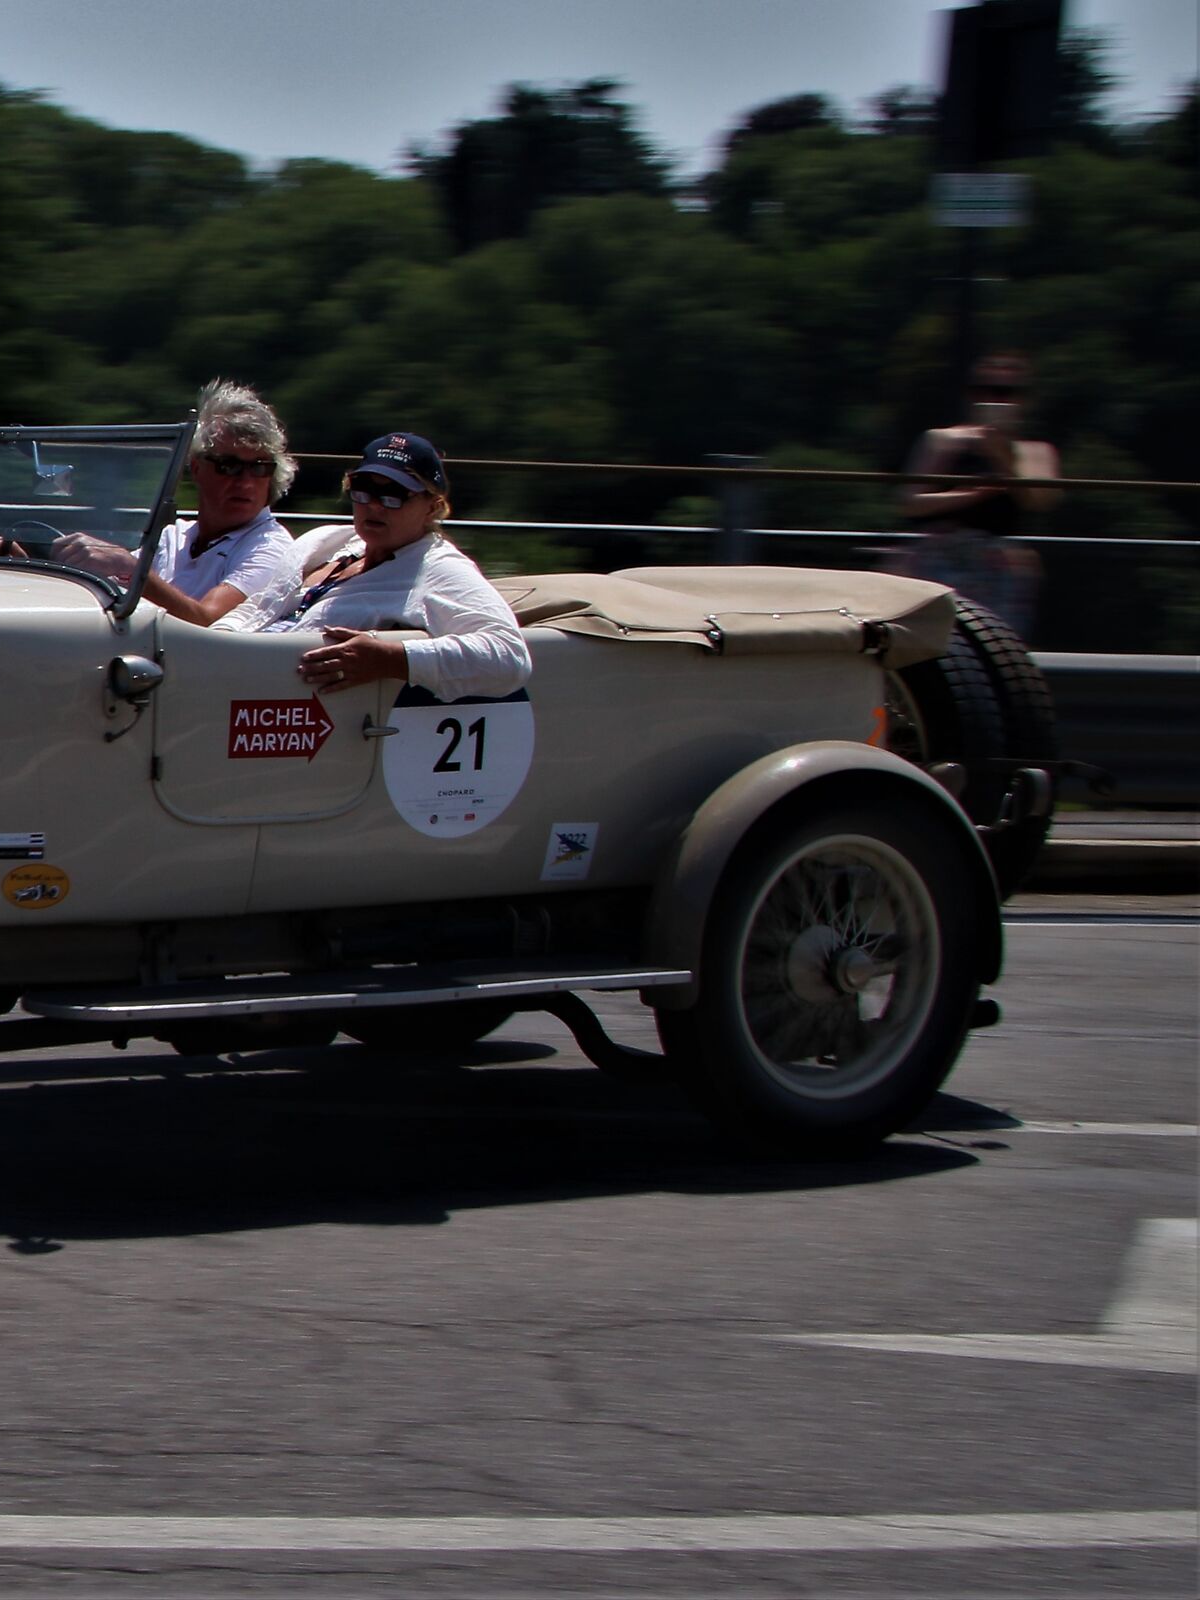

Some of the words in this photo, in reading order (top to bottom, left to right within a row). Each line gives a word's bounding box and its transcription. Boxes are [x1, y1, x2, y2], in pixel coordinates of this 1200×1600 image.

[234, 707, 316, 727] MICHEL
[233, 732, 316, 752] MARYAN
[433, 716, 486, 773] 21
[437, 789, 475, 797] CHOPARD
